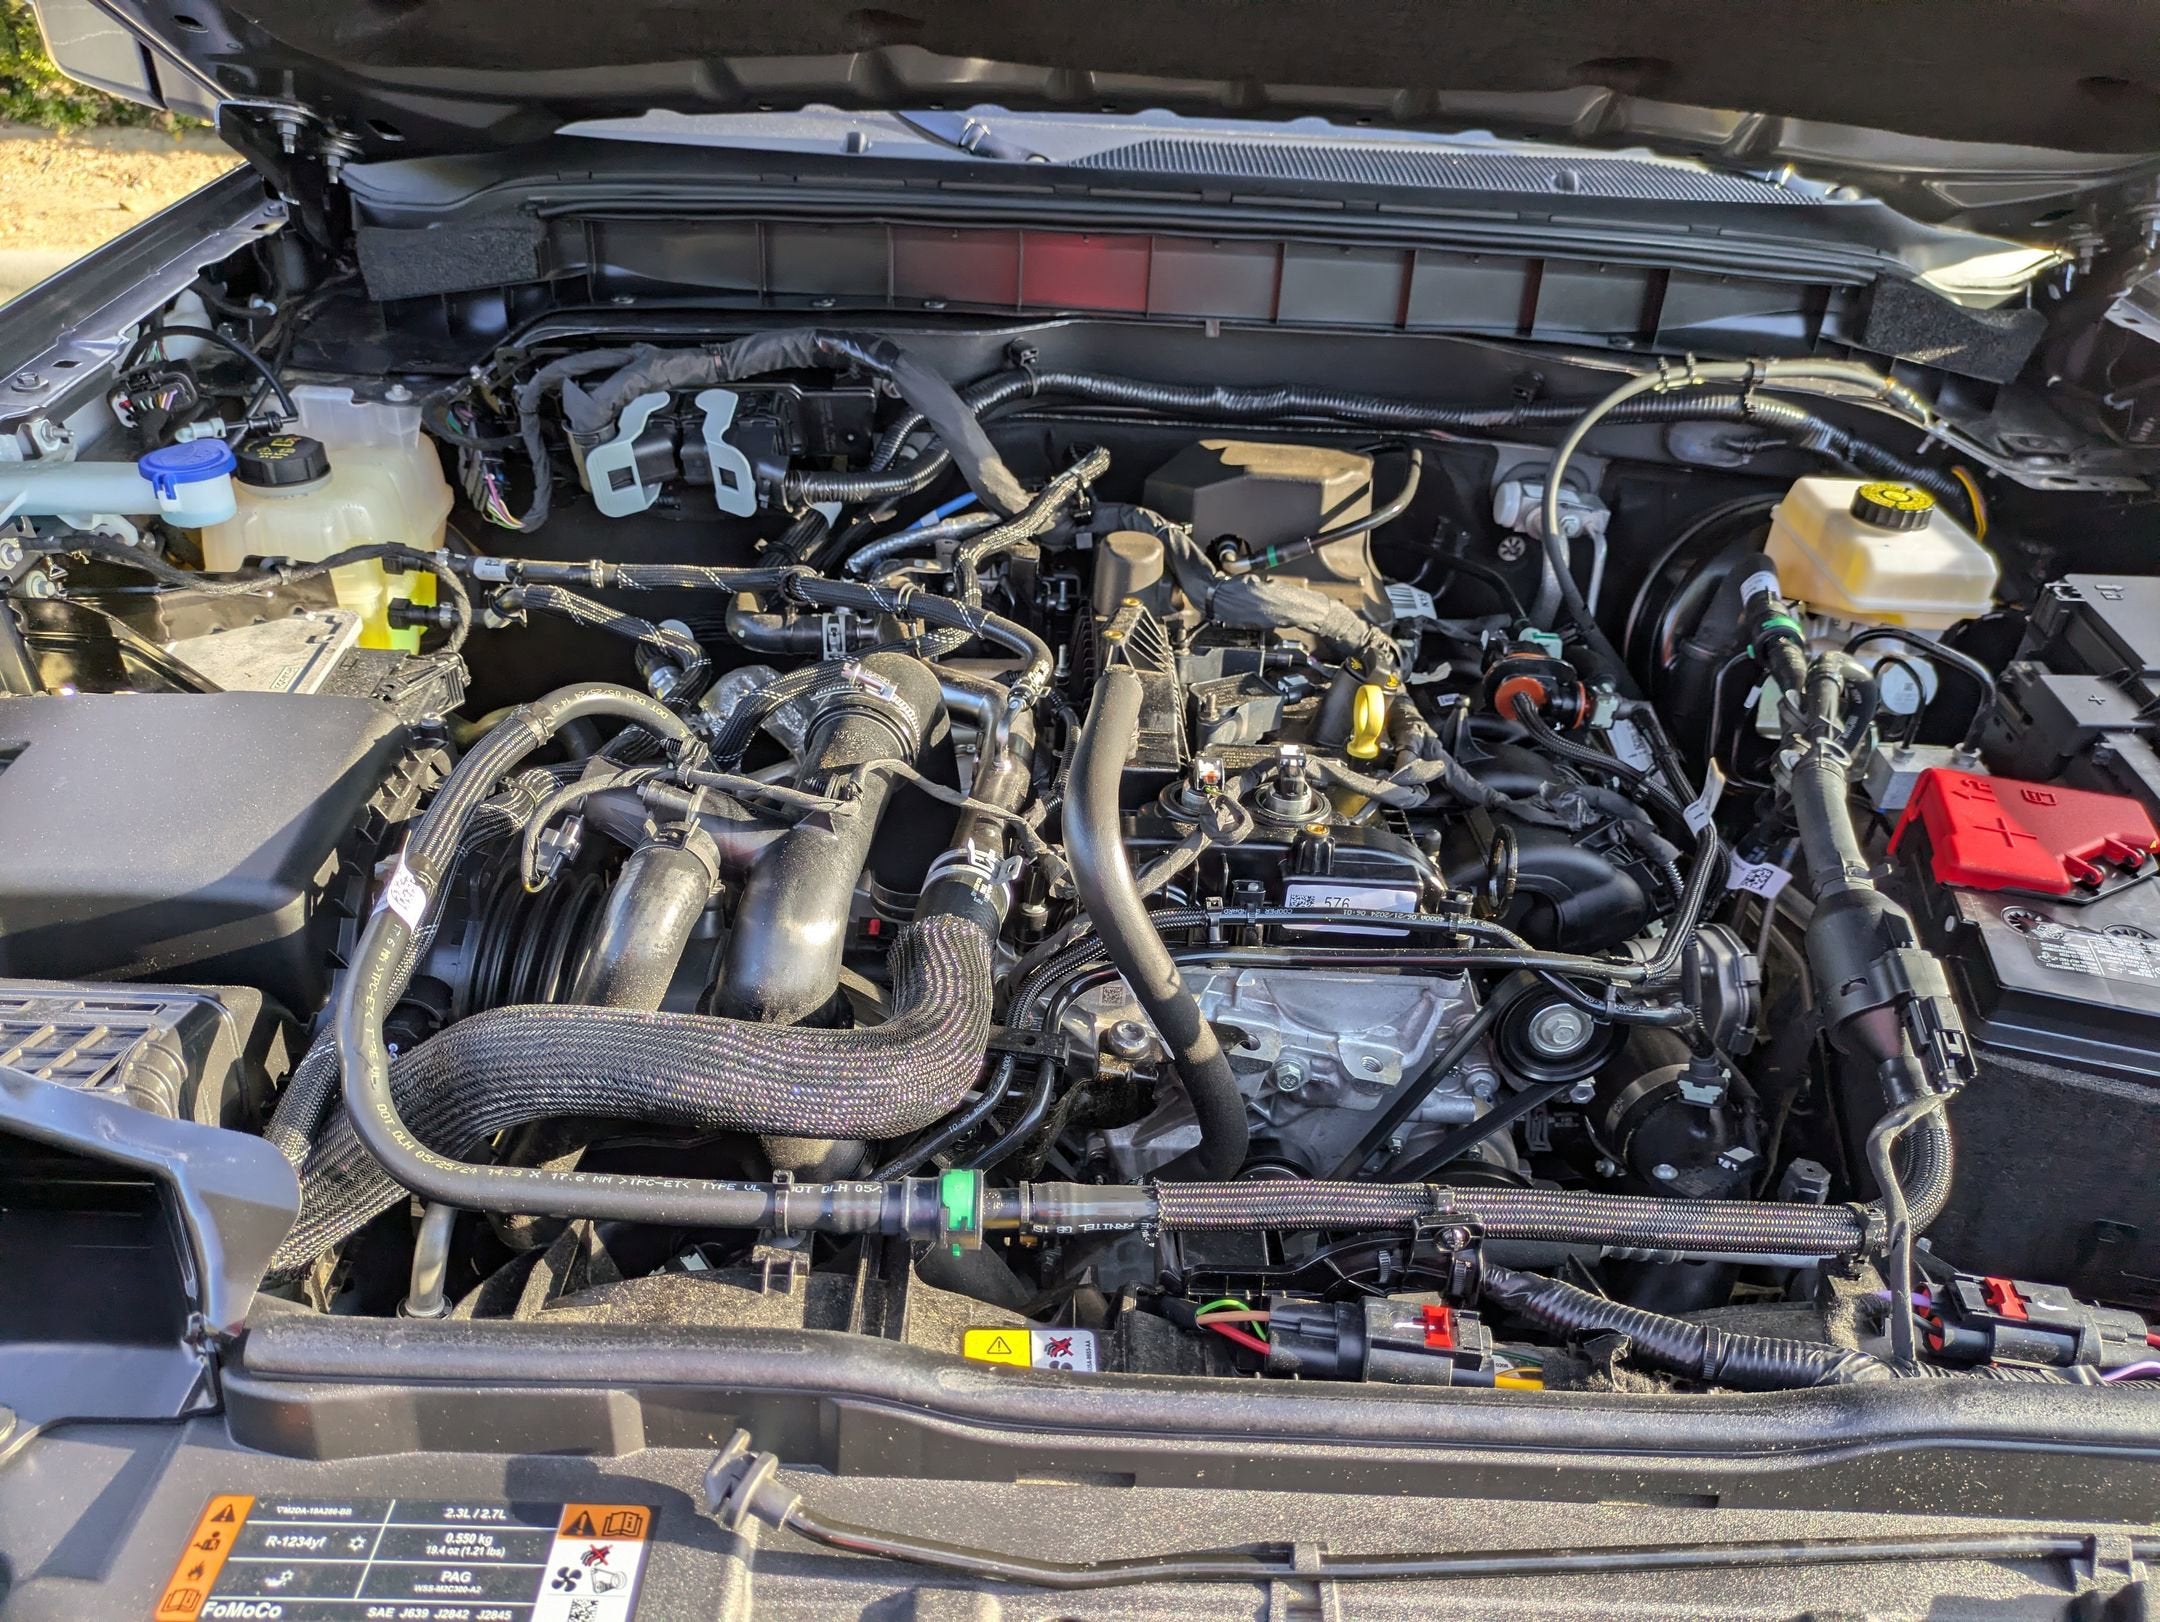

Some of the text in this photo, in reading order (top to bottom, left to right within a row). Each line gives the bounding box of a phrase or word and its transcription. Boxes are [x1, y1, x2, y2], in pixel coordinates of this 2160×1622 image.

[626, 693, 647, 706] DLH
[650, 704, 669, 720] DOT
[376, 1103, 396, 1125] DOT
[392, 1130, 415, 1151] DLH
[487, 1168, 523, 1178] 14.3
[551, 1172, 587, 1183] 17.6
[592, 1175, 613, 1185] MM
[702, 1181, 737, 1191] TYPE
[821, 1184, 848, 1194] DLH
[444, 1507, 471, 1519] 2.3L
[480, 1509, 507, 1519] 2.7L
[265, 1535, 327, 1549] R-1234yf
[445, 1532, 494, 1547] 0.550 kg
[426, 1545, 505, 1558] 19.4 oz (1.21 lbs)
[440, 1570, 472, 1583] PAG
[200, 1602, 283, 1619] FoMoCo
[367, 1606, 513, 1621] SAE J639 J2842 J2845
